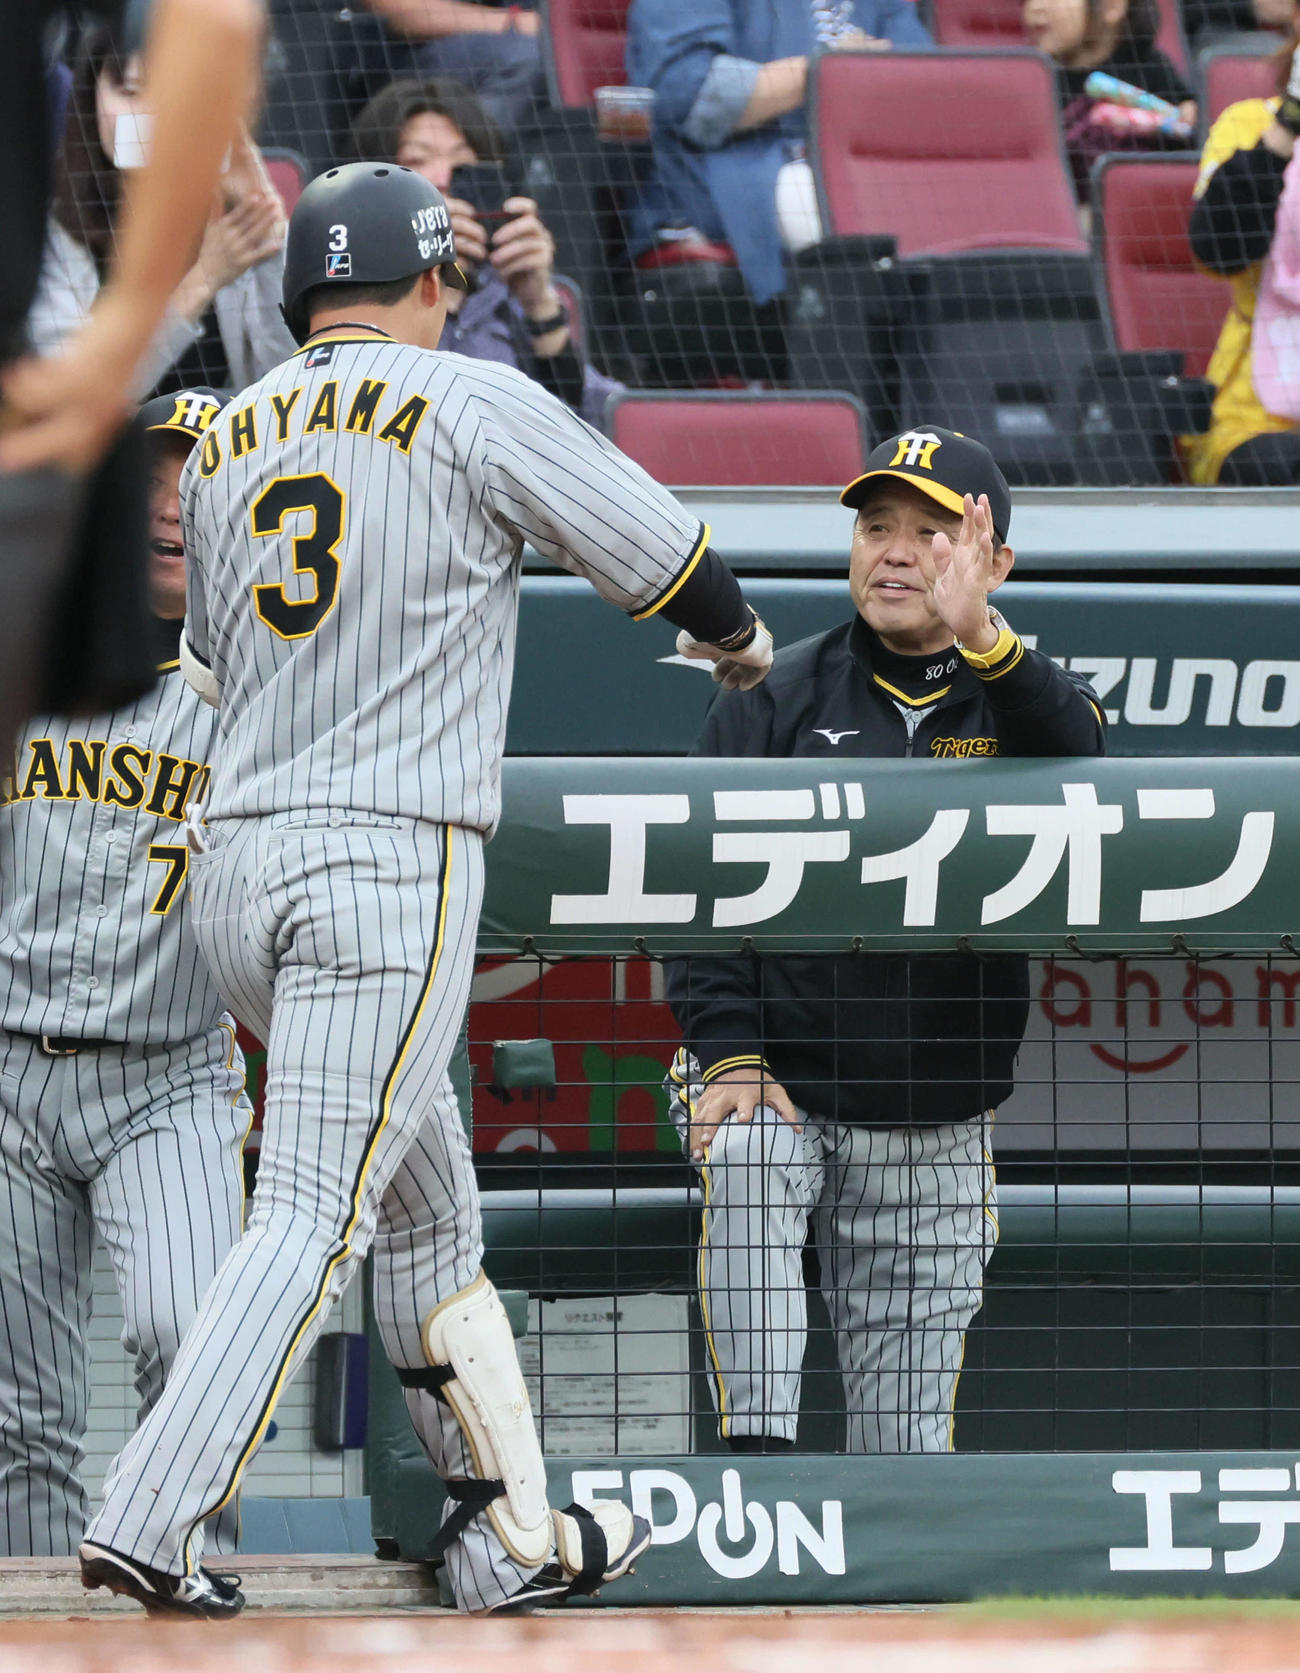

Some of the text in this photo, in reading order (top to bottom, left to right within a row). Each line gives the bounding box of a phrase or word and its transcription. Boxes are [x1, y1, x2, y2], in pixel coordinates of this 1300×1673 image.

[328, 224, 348, 252] 3
[200, 378, 432, 479] OHYAMA
[251, 471, 347, 641] 3
[550, 782, 1275, 928] エディオン
